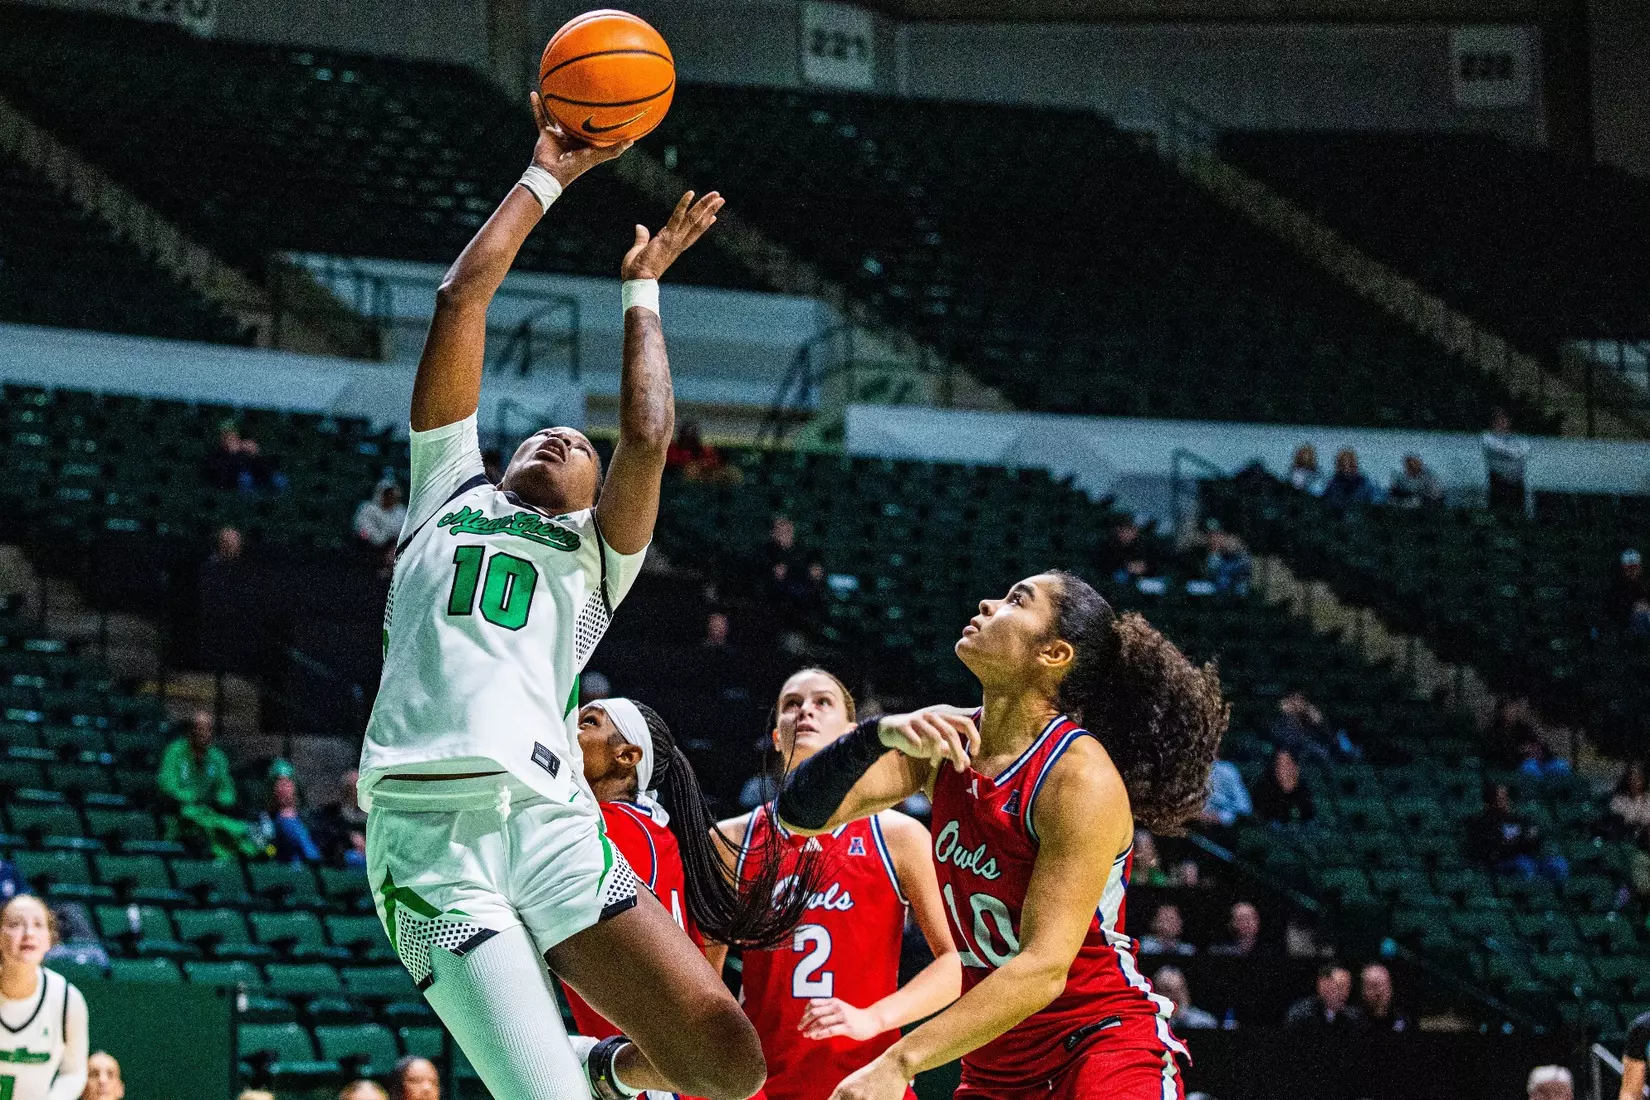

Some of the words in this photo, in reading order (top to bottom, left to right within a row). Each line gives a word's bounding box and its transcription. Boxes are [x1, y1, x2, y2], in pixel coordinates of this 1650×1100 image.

[510, 511, 581, 552] Green
[448, 545, 539, 632] 10
[935, 819, 1001, 880] Owls
[792, 923, 834, 998] 2
[943, 883, 1020, 968] 10
